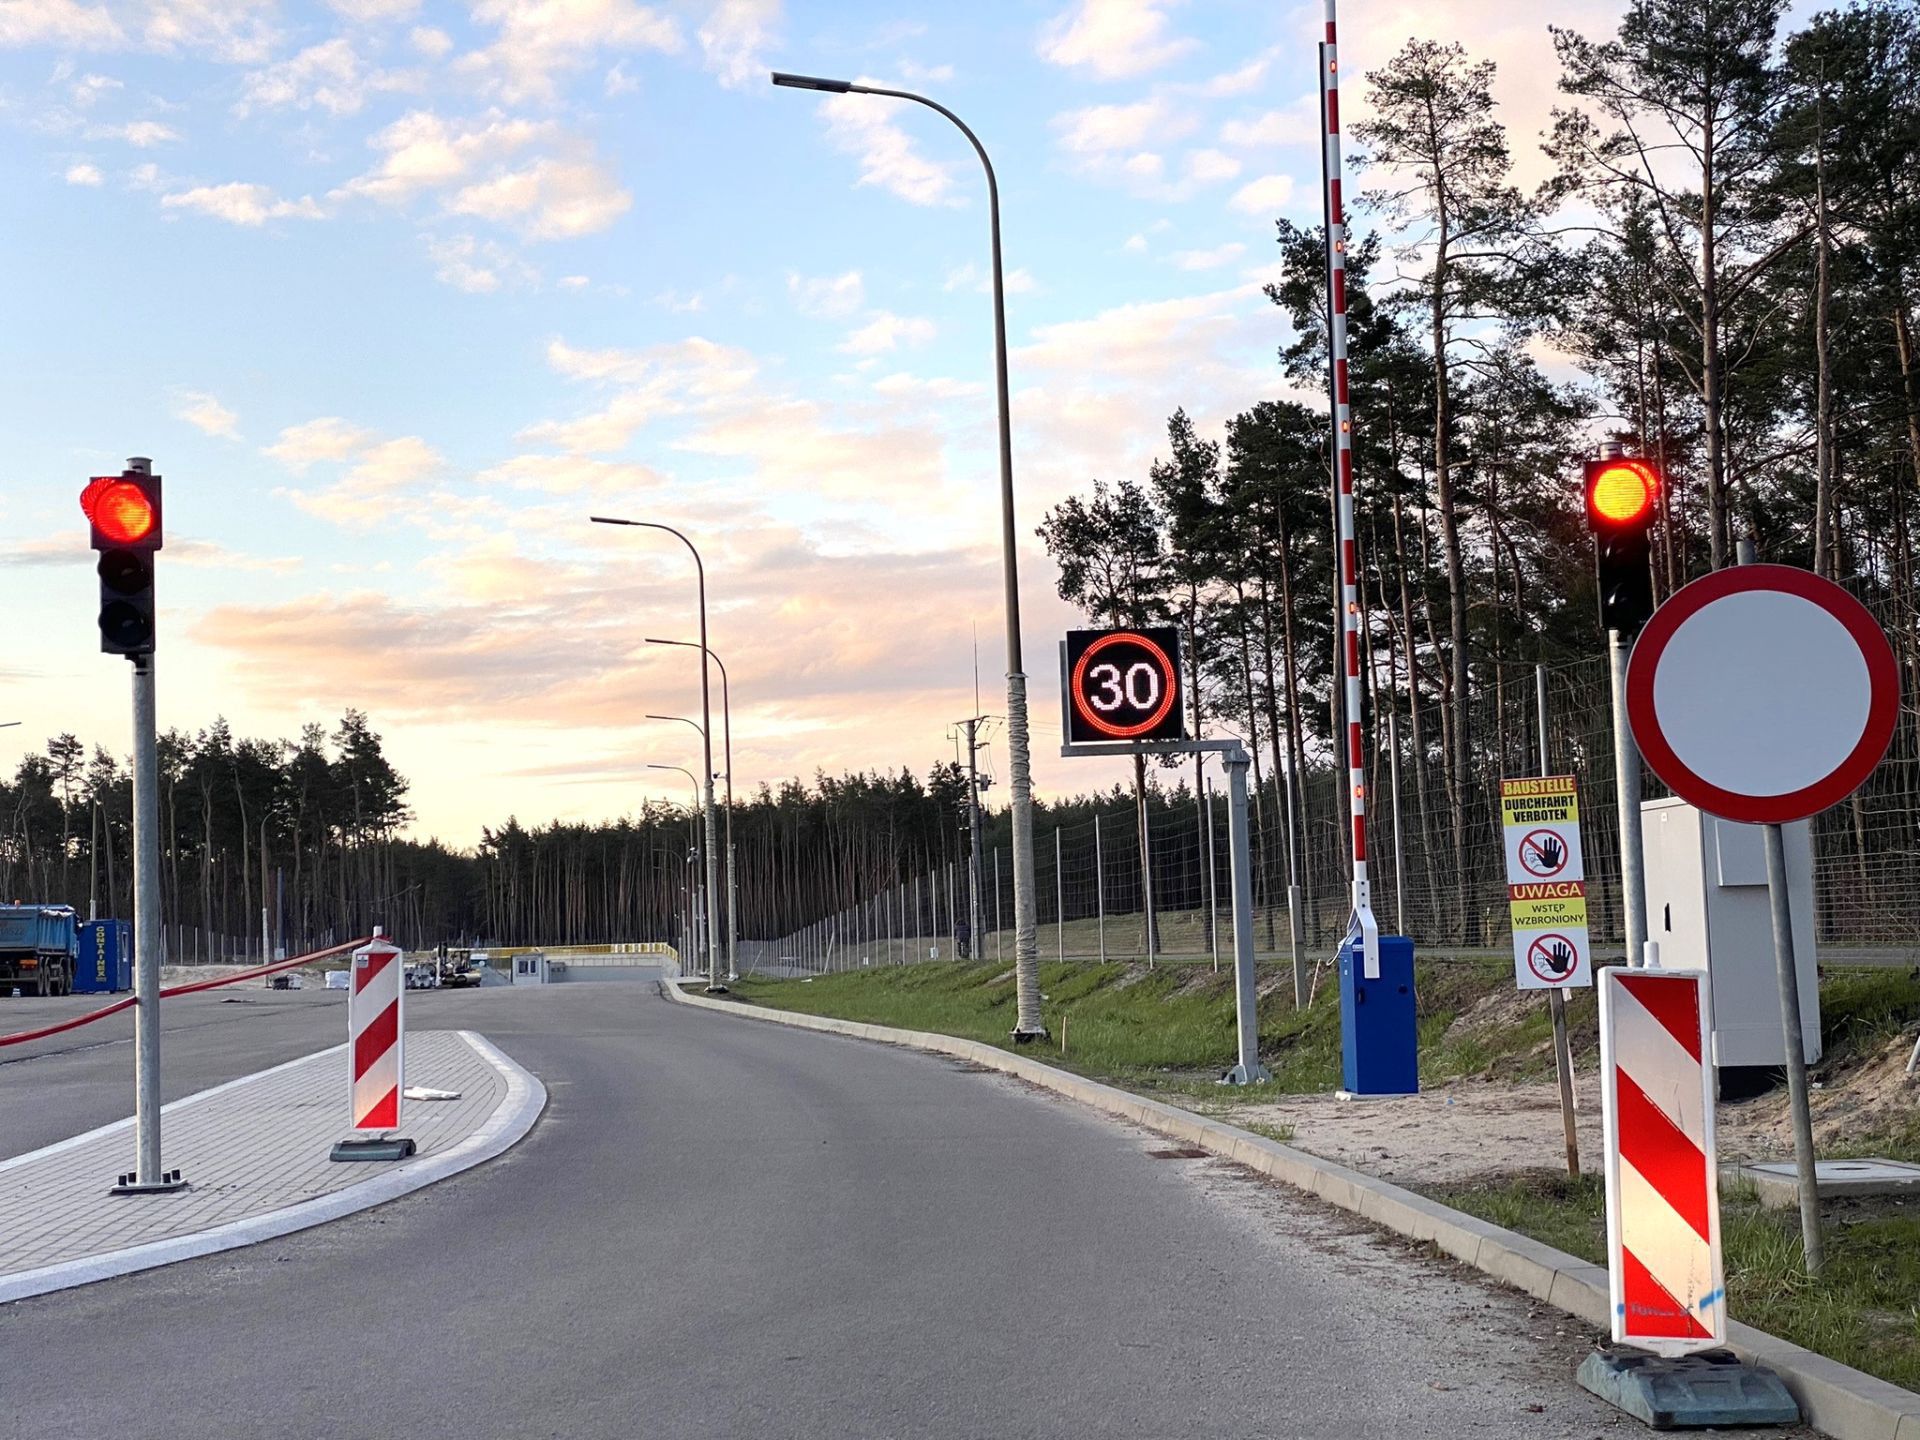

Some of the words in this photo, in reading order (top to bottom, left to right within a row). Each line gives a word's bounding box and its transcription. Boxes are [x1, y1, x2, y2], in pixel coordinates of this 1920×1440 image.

[1090, 663, 1158, 710] 30
[1503, 778, 1574, 795] BAUSTELLE
[1504, 795, 1574, 810] DURCHFAHRT
[1513, 809, 1568, 823] VERBOTEN
[1513, 882, 1582, 899] UWAGA
[1531, 904, 1565, 914] WSTĘP
[1515, 914, 1584, 925] WZBRONIONY
[96, 926, 105, 977] CONTAINEX
